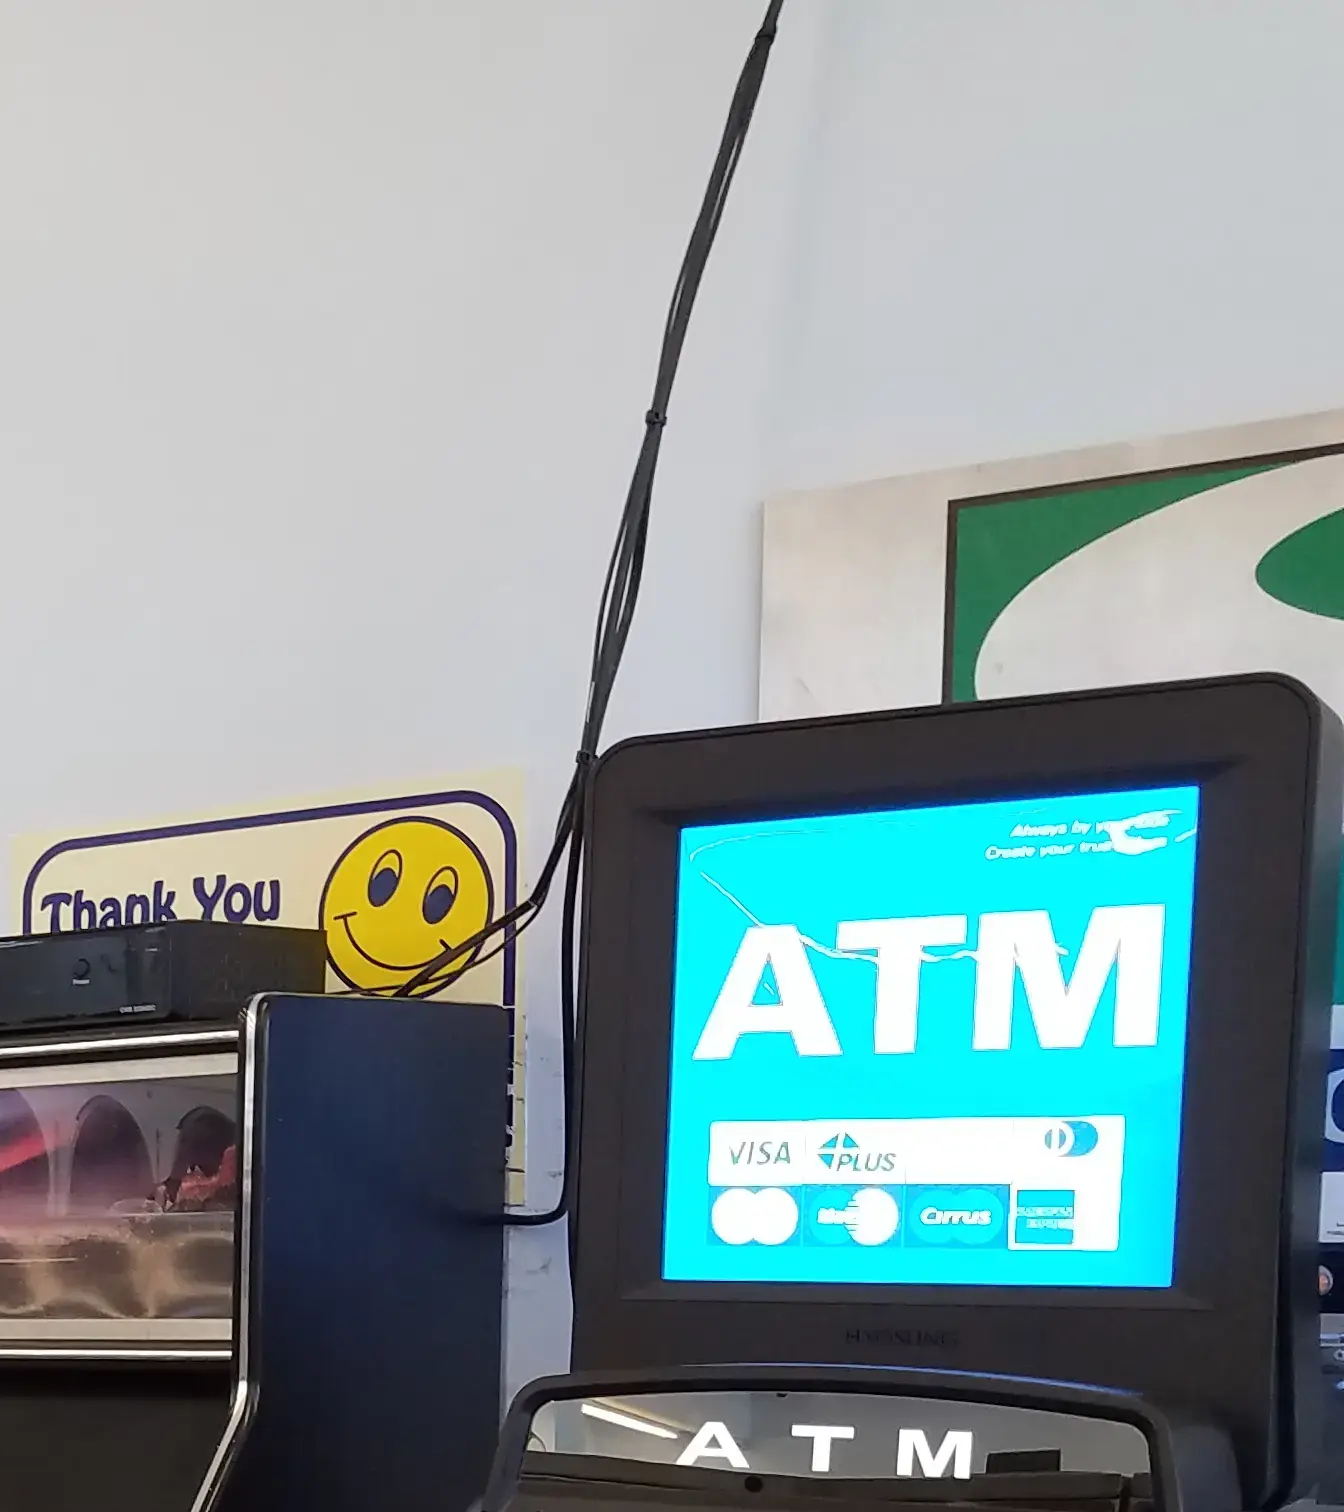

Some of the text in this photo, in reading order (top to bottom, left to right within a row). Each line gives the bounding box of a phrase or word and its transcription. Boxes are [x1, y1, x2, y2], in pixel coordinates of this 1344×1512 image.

[40, 874, 281, 934] Thank You
[691, 903, 1166, 1061] ATM
[728, 1141, 792, 1166] VISA
[836, 1152, 897, 1172] PLUS
[920, 1206, 992, 1226] Cirrus
